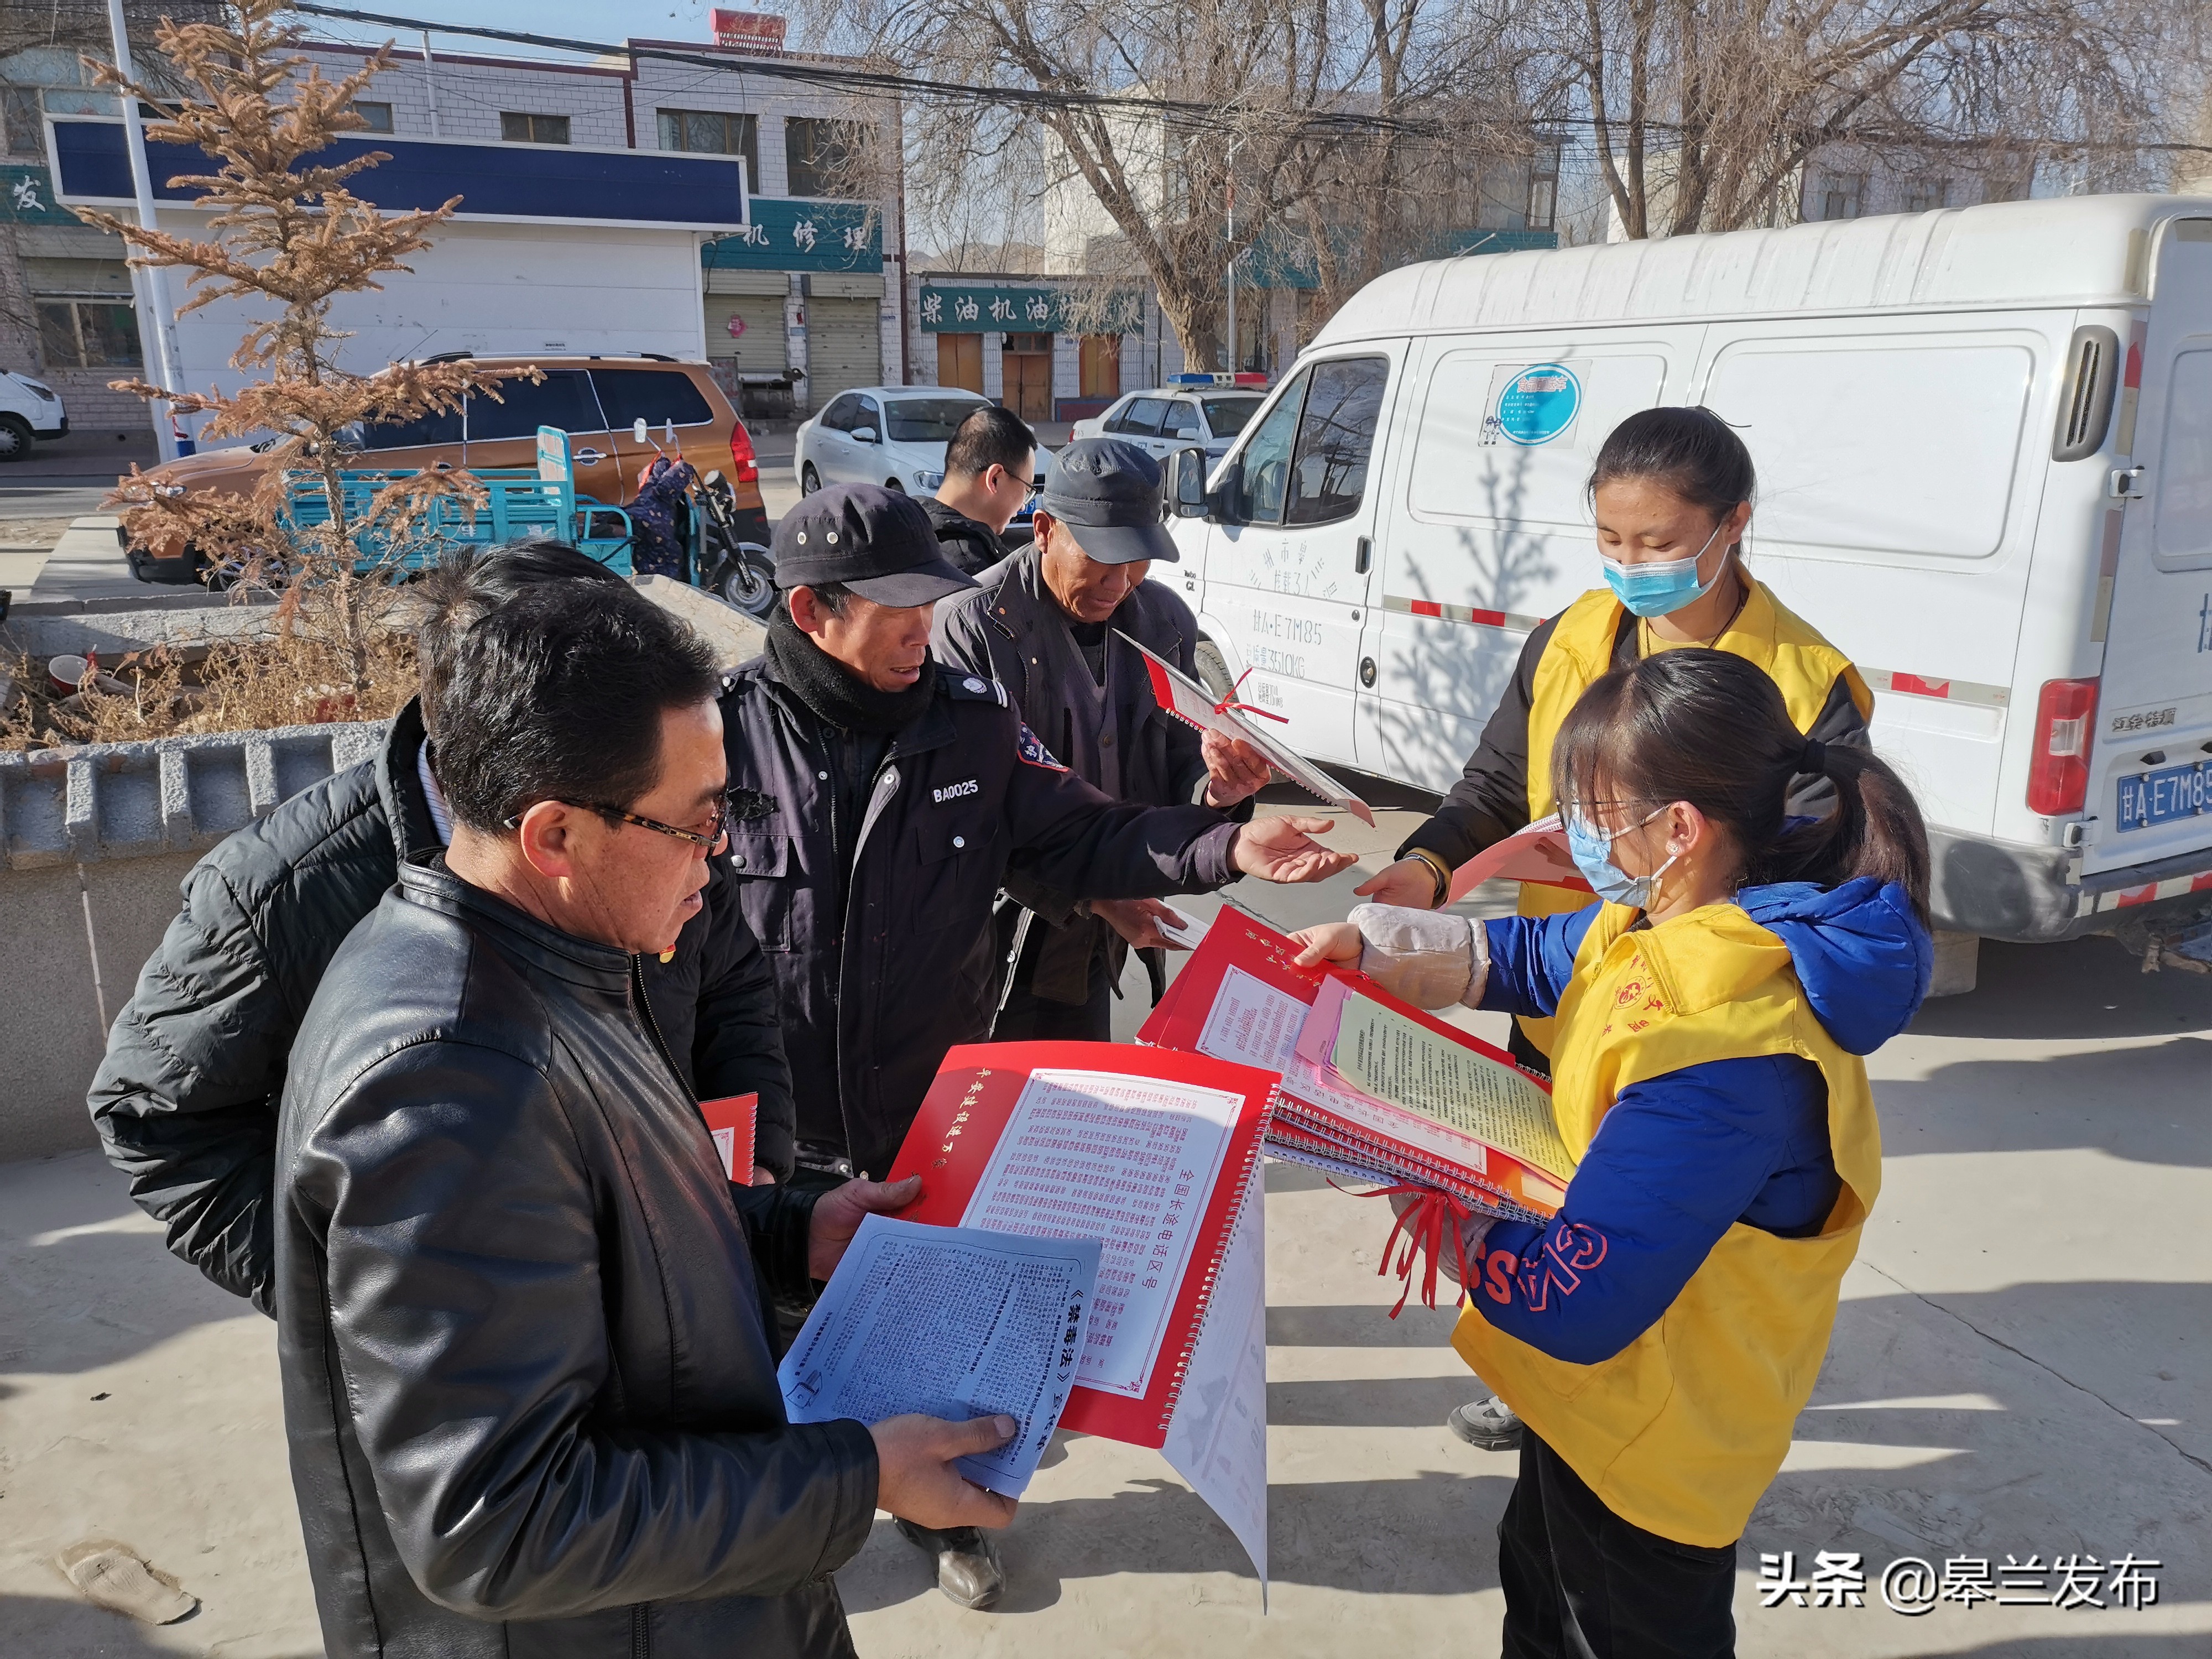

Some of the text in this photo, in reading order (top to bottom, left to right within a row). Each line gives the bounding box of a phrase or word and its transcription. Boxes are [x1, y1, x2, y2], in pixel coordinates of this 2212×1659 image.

[13, 175, 46, 212] 发
[921, 292, 1145, 325] 柴油机油
[933, 779, 978, 803] BA0025
[1141, 1168, 1196, 1291] 全国长途电话区号
